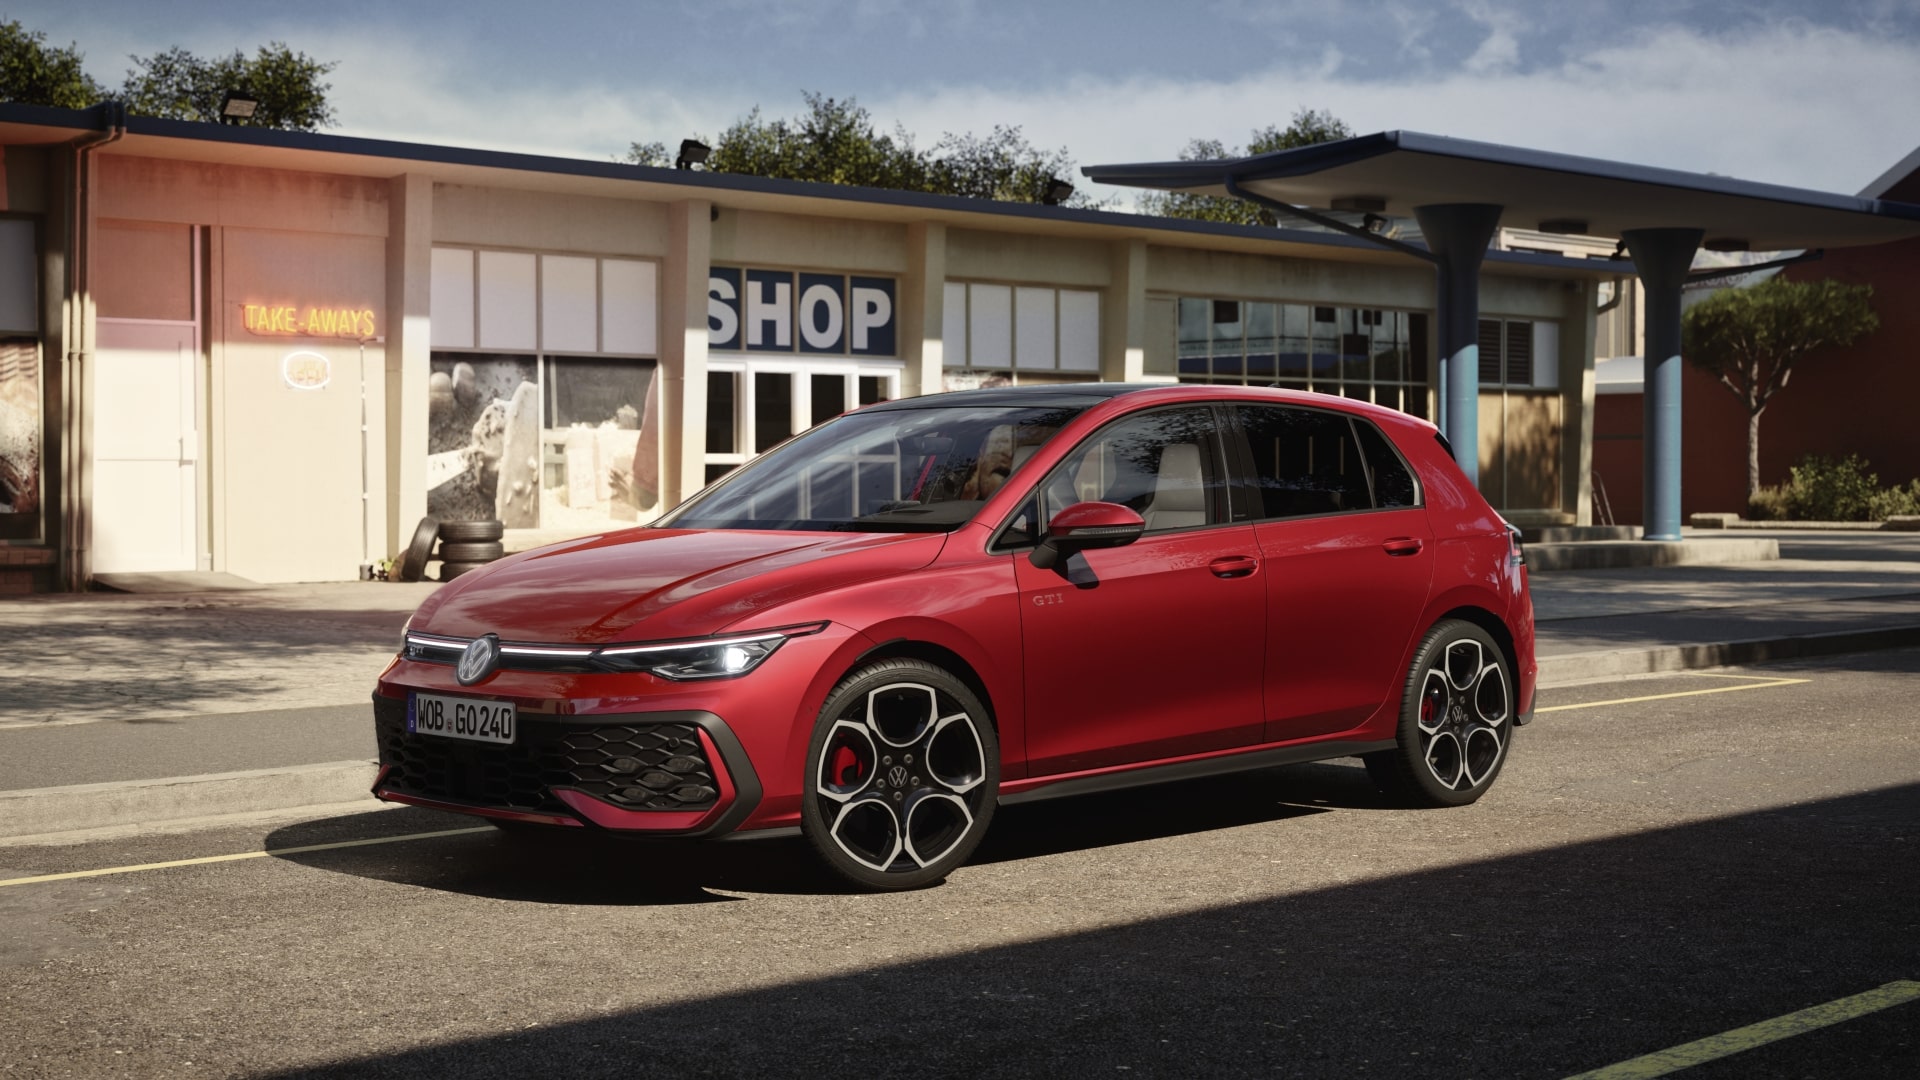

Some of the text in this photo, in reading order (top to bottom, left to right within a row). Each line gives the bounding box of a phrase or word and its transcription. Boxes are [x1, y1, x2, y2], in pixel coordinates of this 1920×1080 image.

[245, 305, 375, 336] TAKE-AWAYS
[708, 277, 892, 349] SHOP
[1033, 593, 1064, 606] GTI
[417, 698, 444, 730] WOB
